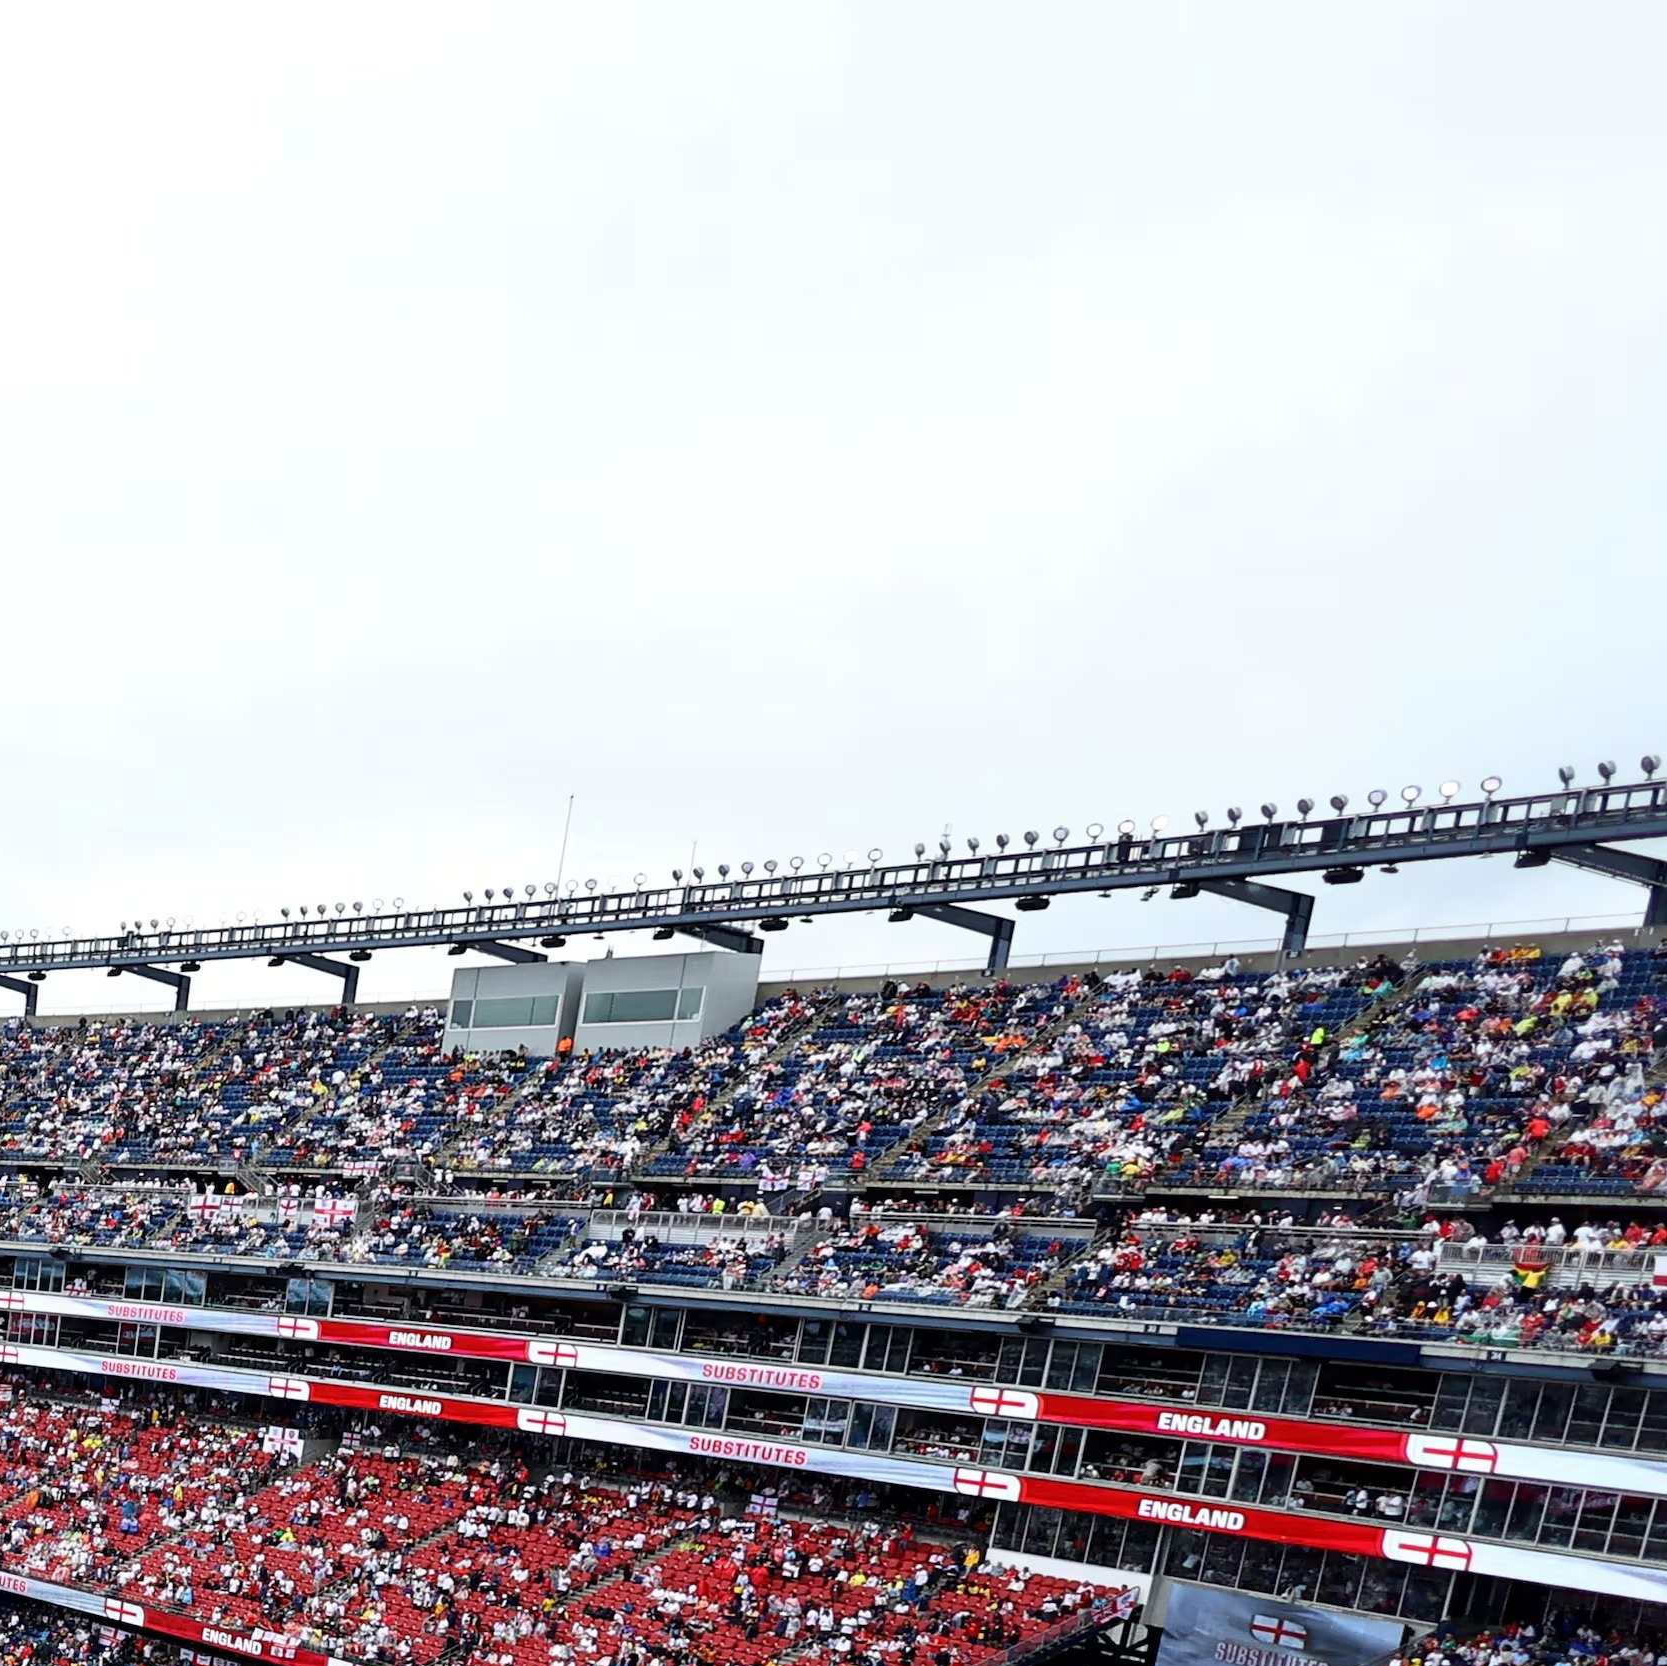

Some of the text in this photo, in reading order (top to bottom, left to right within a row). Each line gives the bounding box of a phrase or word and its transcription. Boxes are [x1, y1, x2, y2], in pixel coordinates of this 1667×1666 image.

[109, 1306, 183, 1322] SUBSTITUTES
[389, 1331, 452, 1350] ENGLAND
[103, 1362, 177, 1380] SUBSTITUTES
[704, 1364, 821, 1389] SUBSTITUTES
[379, 1395, 441, 1415] ENGLAND
[1158, 1412, 1265, 1441] ENGLAND
[691, 1437, 806, 1465] SUBSTITUTES
[1139, 1499, 1244, 1530] ENGLAND
[203, 1628, 262, 1655] ENGLAND
